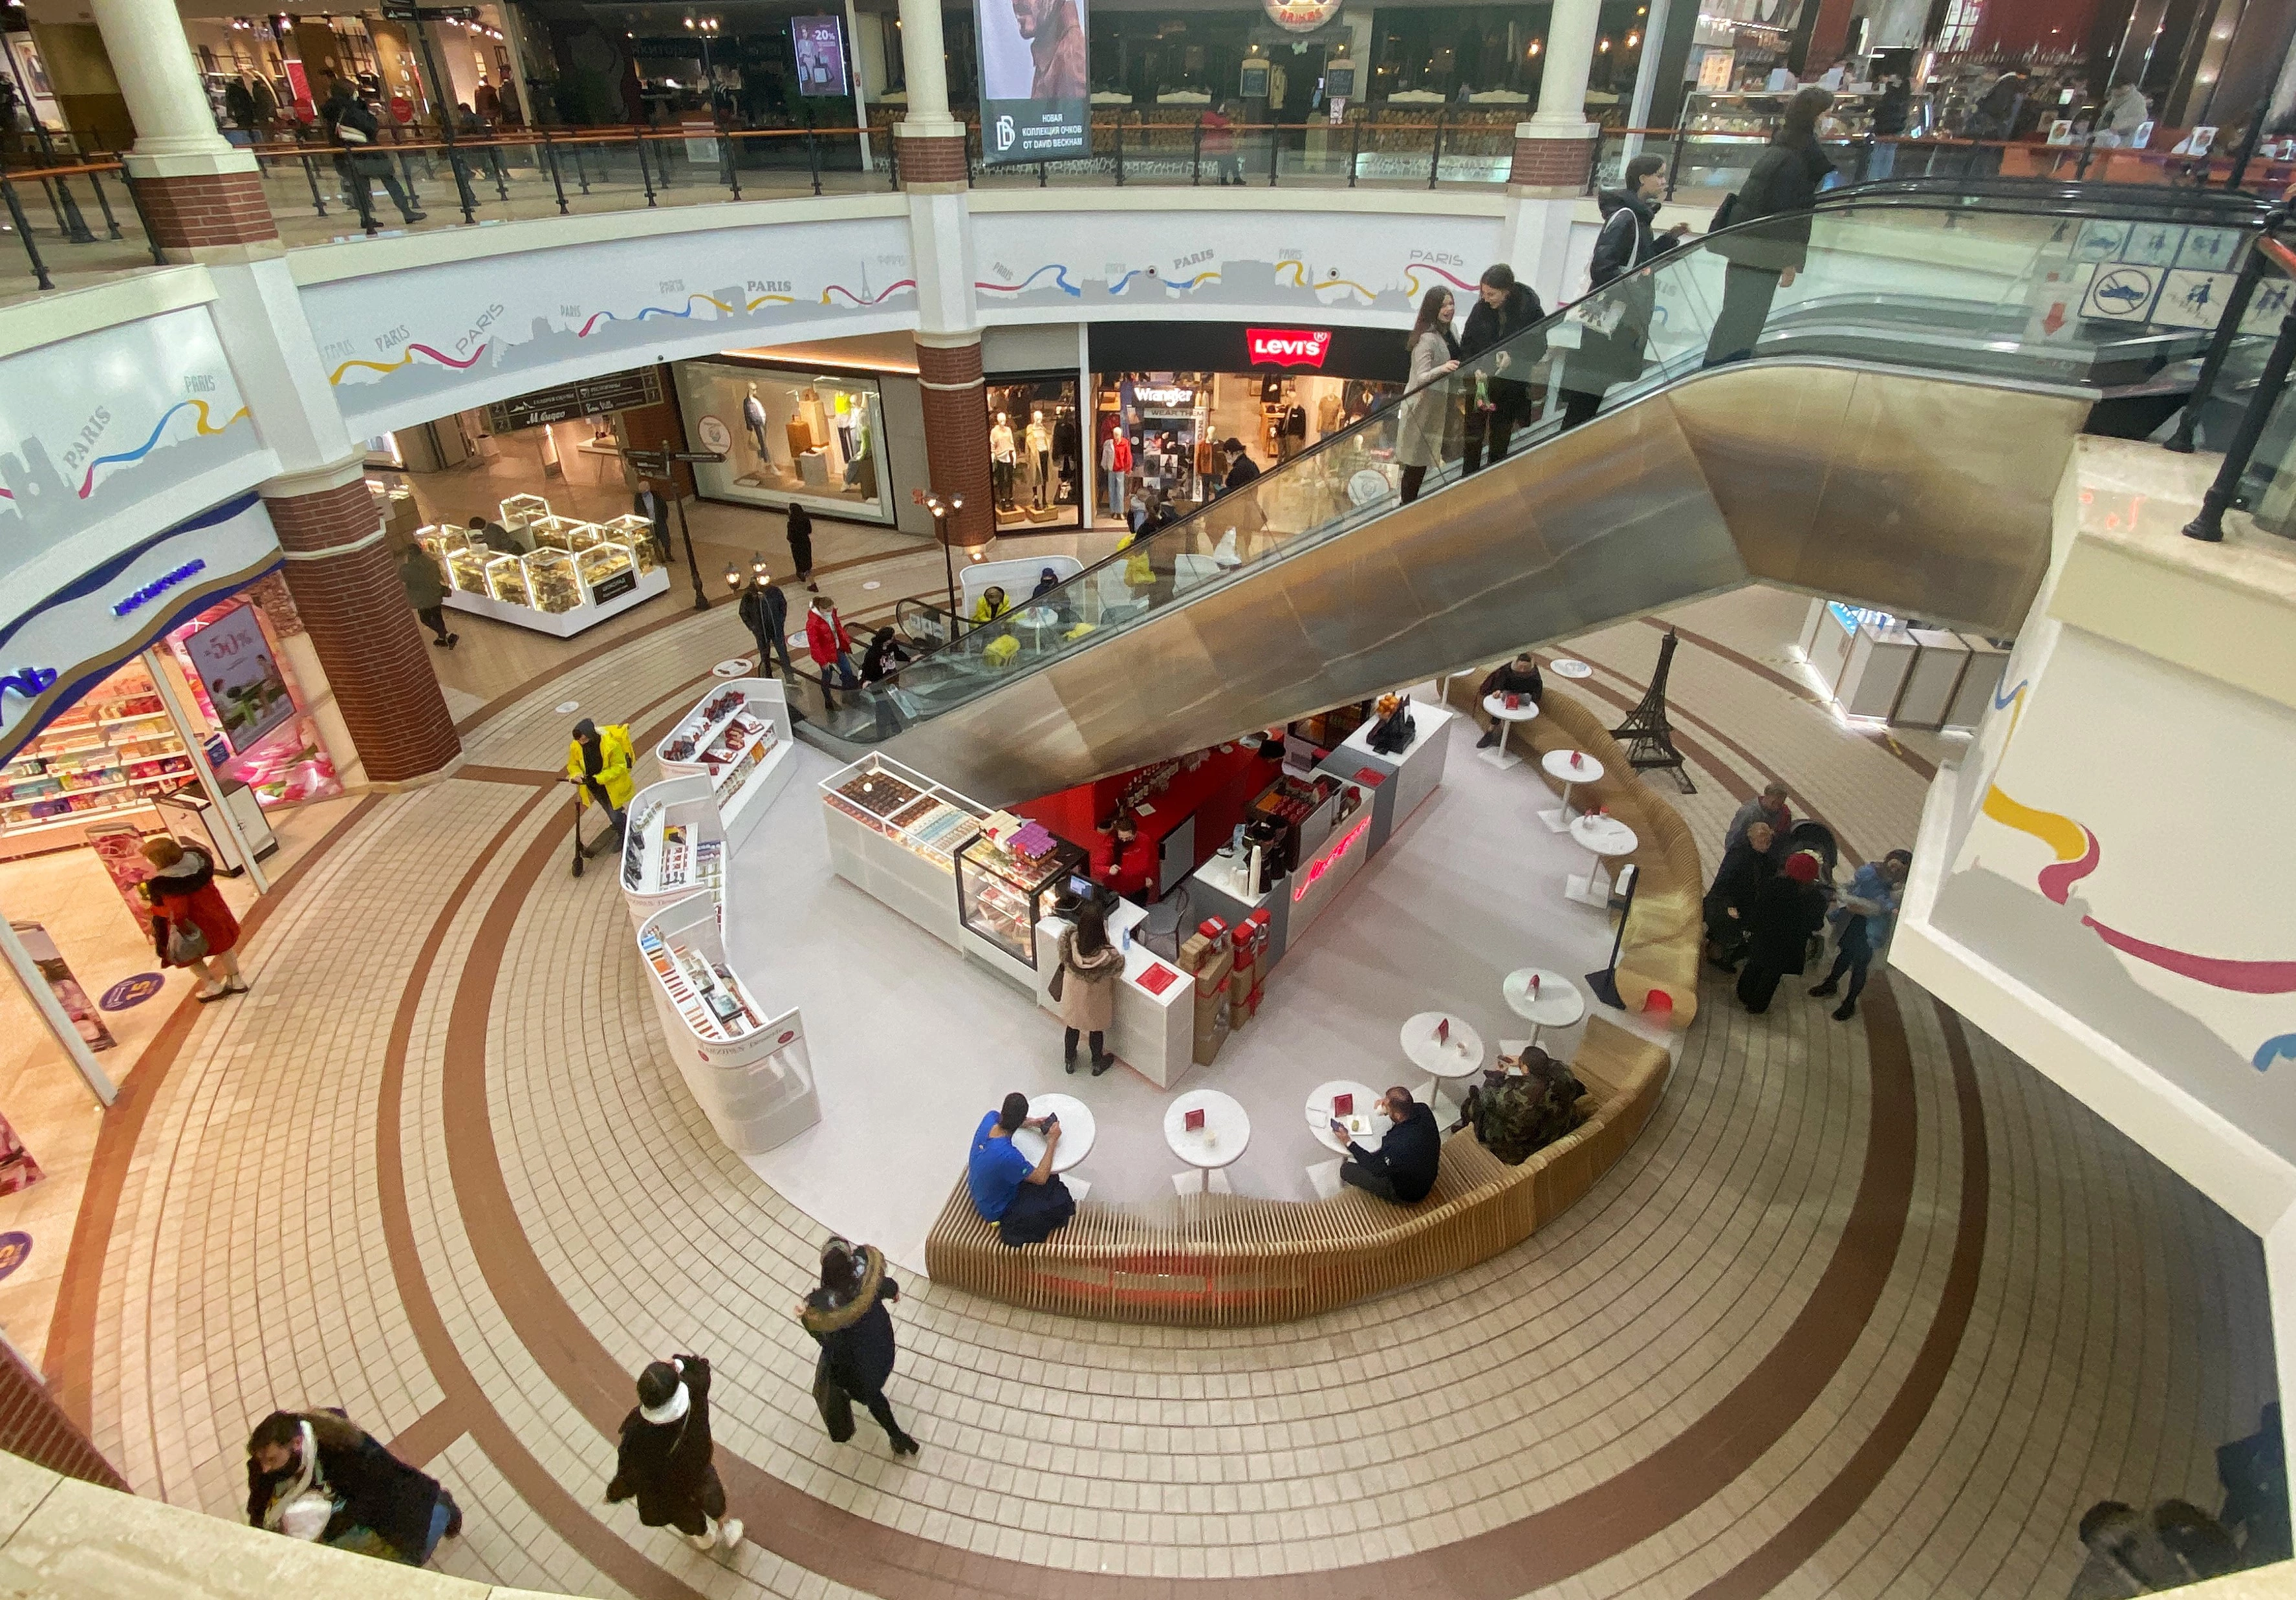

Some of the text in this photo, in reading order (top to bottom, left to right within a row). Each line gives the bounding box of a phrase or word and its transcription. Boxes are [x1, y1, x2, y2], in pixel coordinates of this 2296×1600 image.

[1042, 113, 1063, 123] НОВАЯ
[1022, 125, 1083, 136] КОЛЛЕКЦИЯ ОЧКОВ
[1023, 137, 1083, 149] ОТ DAVID BECKHAM
[1173, 249, 1215, 270] PARIS
[1410, 250, 1464, 266] PARIS
[747, 280, 792, 292] PARIS
[374, 324, 411, 352] PARIS
[455, 303, 504, 355] PARIS
[183, 374, 216, 393] PARIS
[1134, 387, 1193, 407] Wrangler
[62, 405, 111, 470] PARIS
